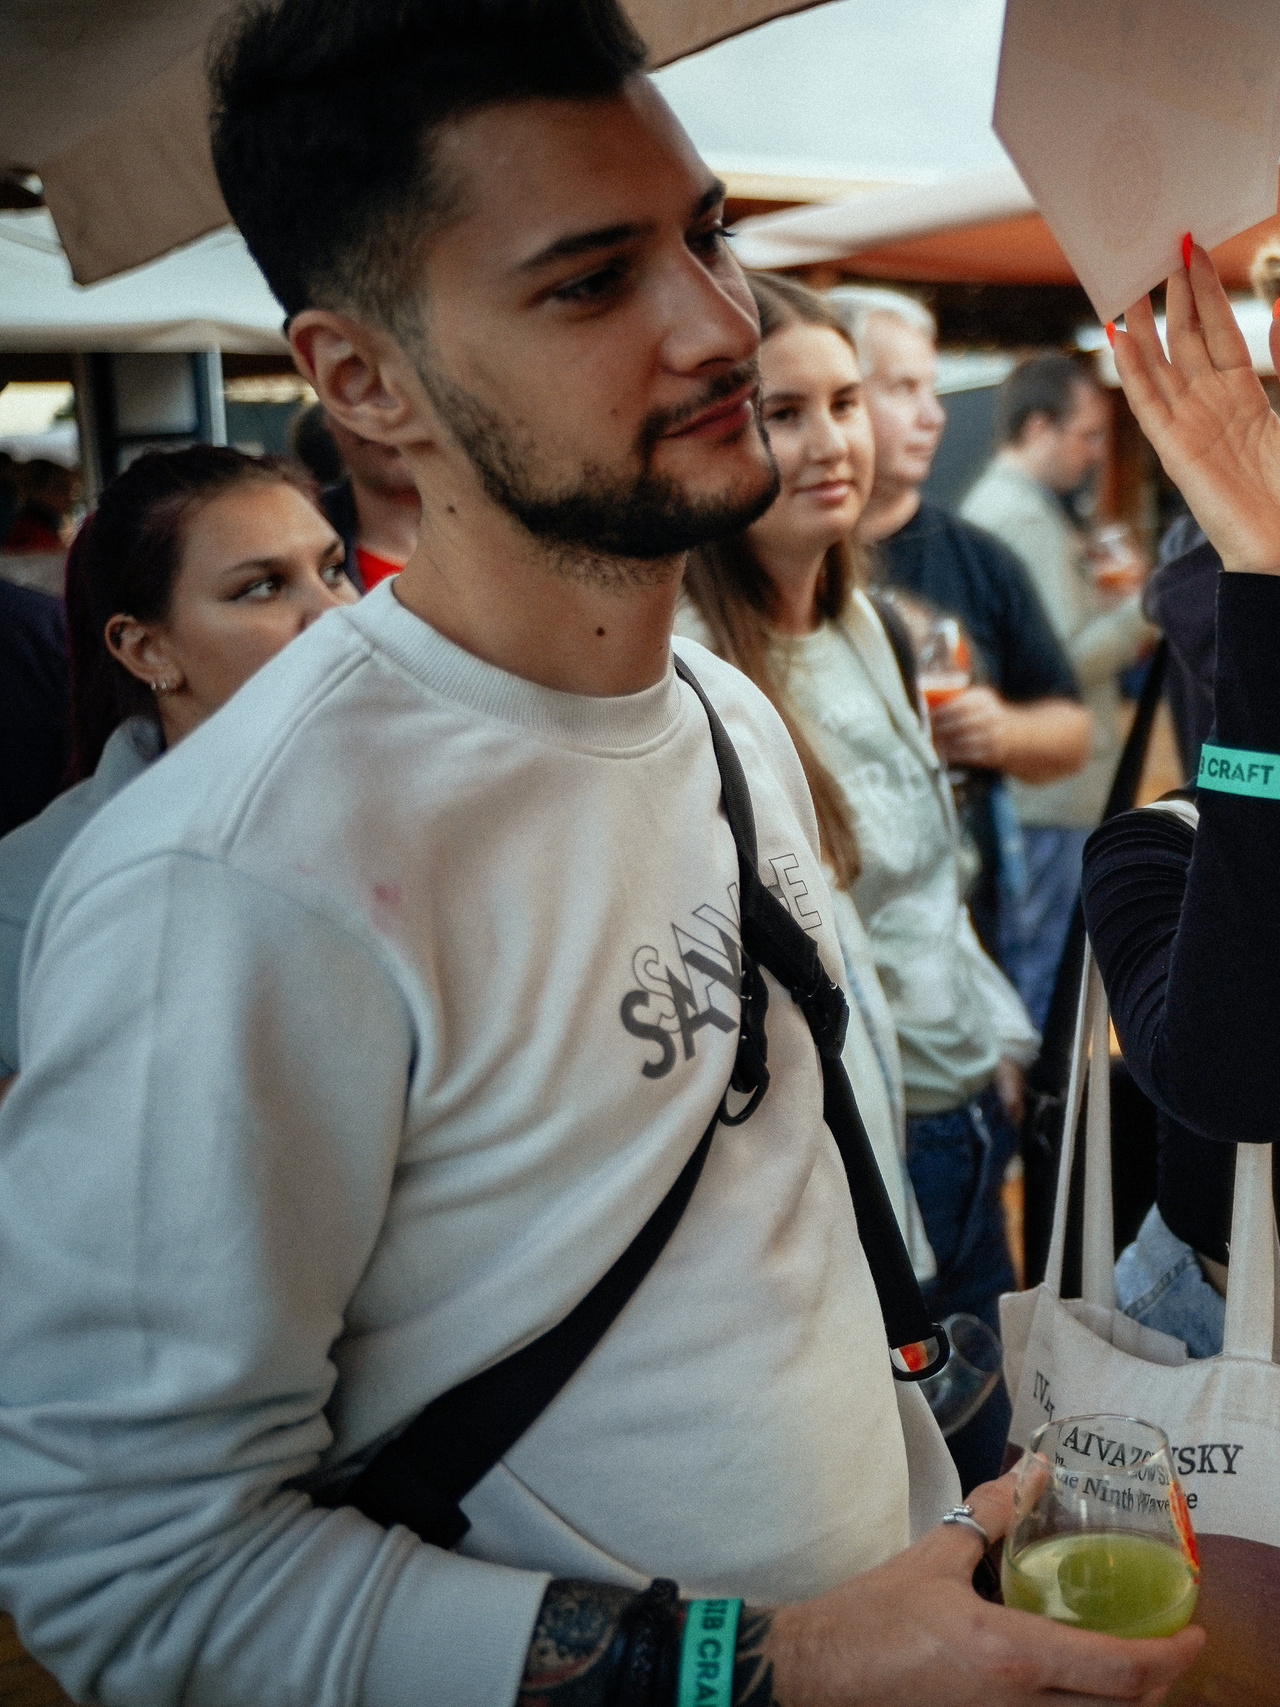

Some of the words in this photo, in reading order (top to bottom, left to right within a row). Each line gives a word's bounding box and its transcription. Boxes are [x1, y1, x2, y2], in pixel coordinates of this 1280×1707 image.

[1208, 757, 1274, 786] CRAFT
[1062, 1425, 1244, 1475] AIVAZSKY
[696, 1638, 722, 1707] CRA
